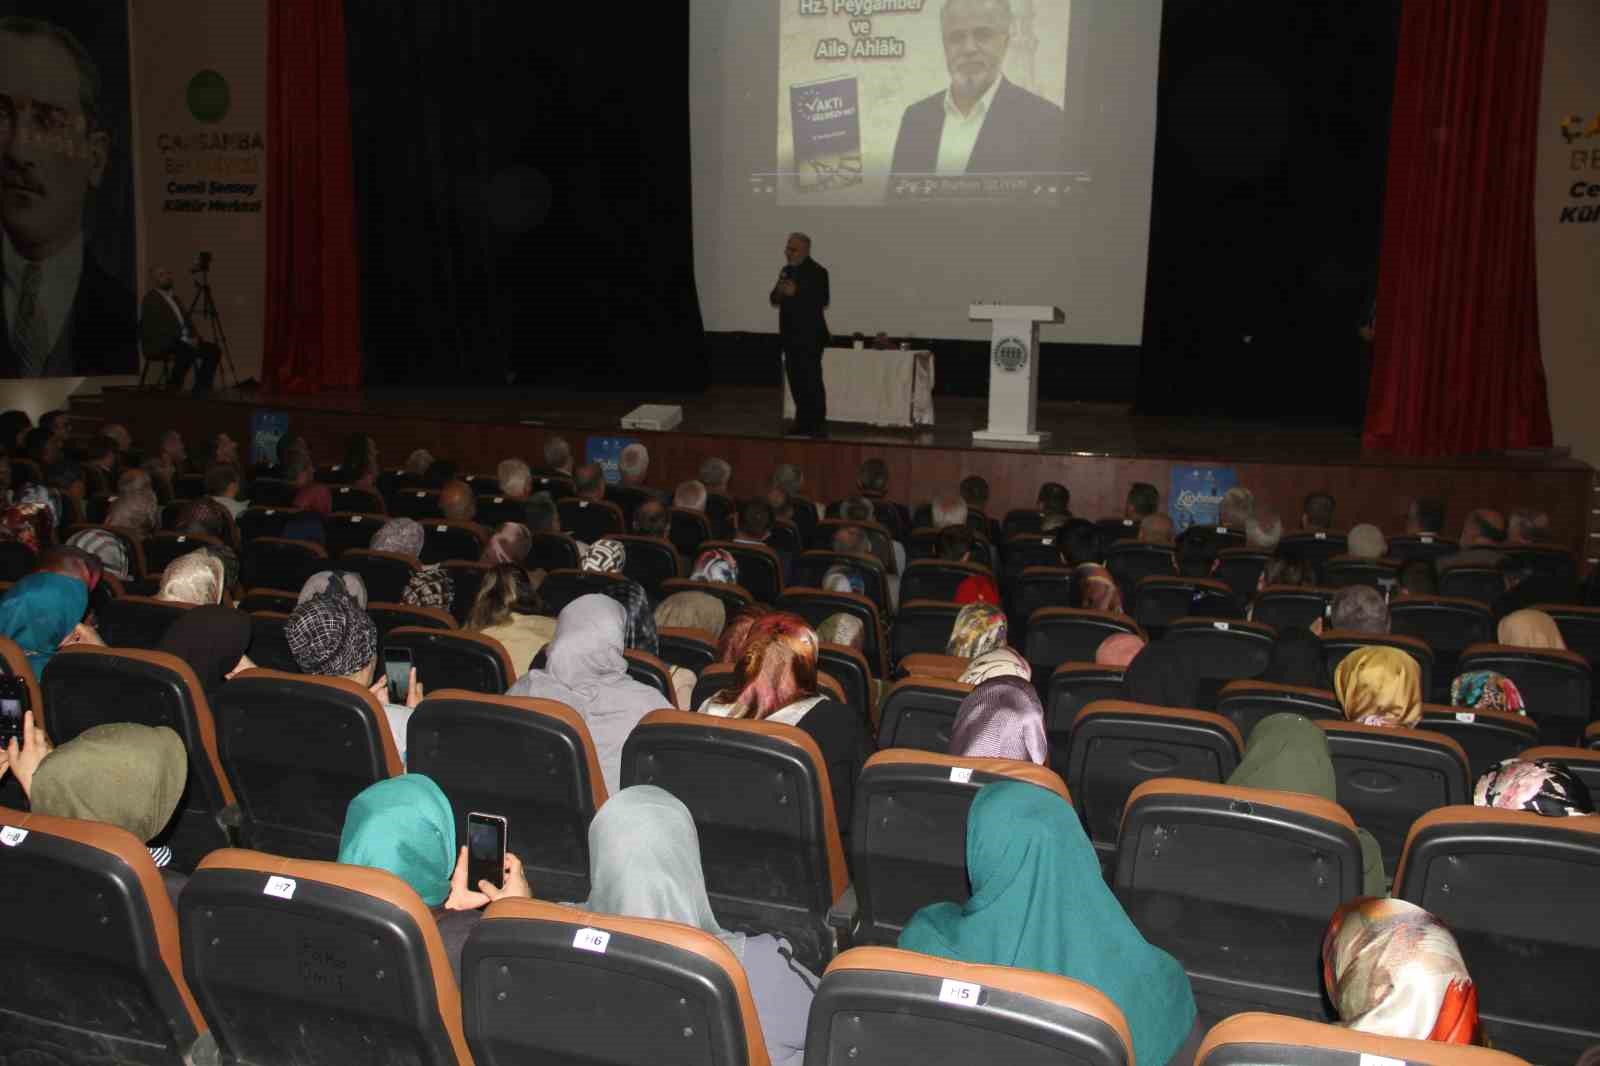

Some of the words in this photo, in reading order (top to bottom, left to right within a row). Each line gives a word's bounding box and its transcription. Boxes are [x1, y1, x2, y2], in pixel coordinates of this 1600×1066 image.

[850, 20, 871, 35] ve
[816, 40, 847, 58] Aile
[951, 986, 969, 999] H5
